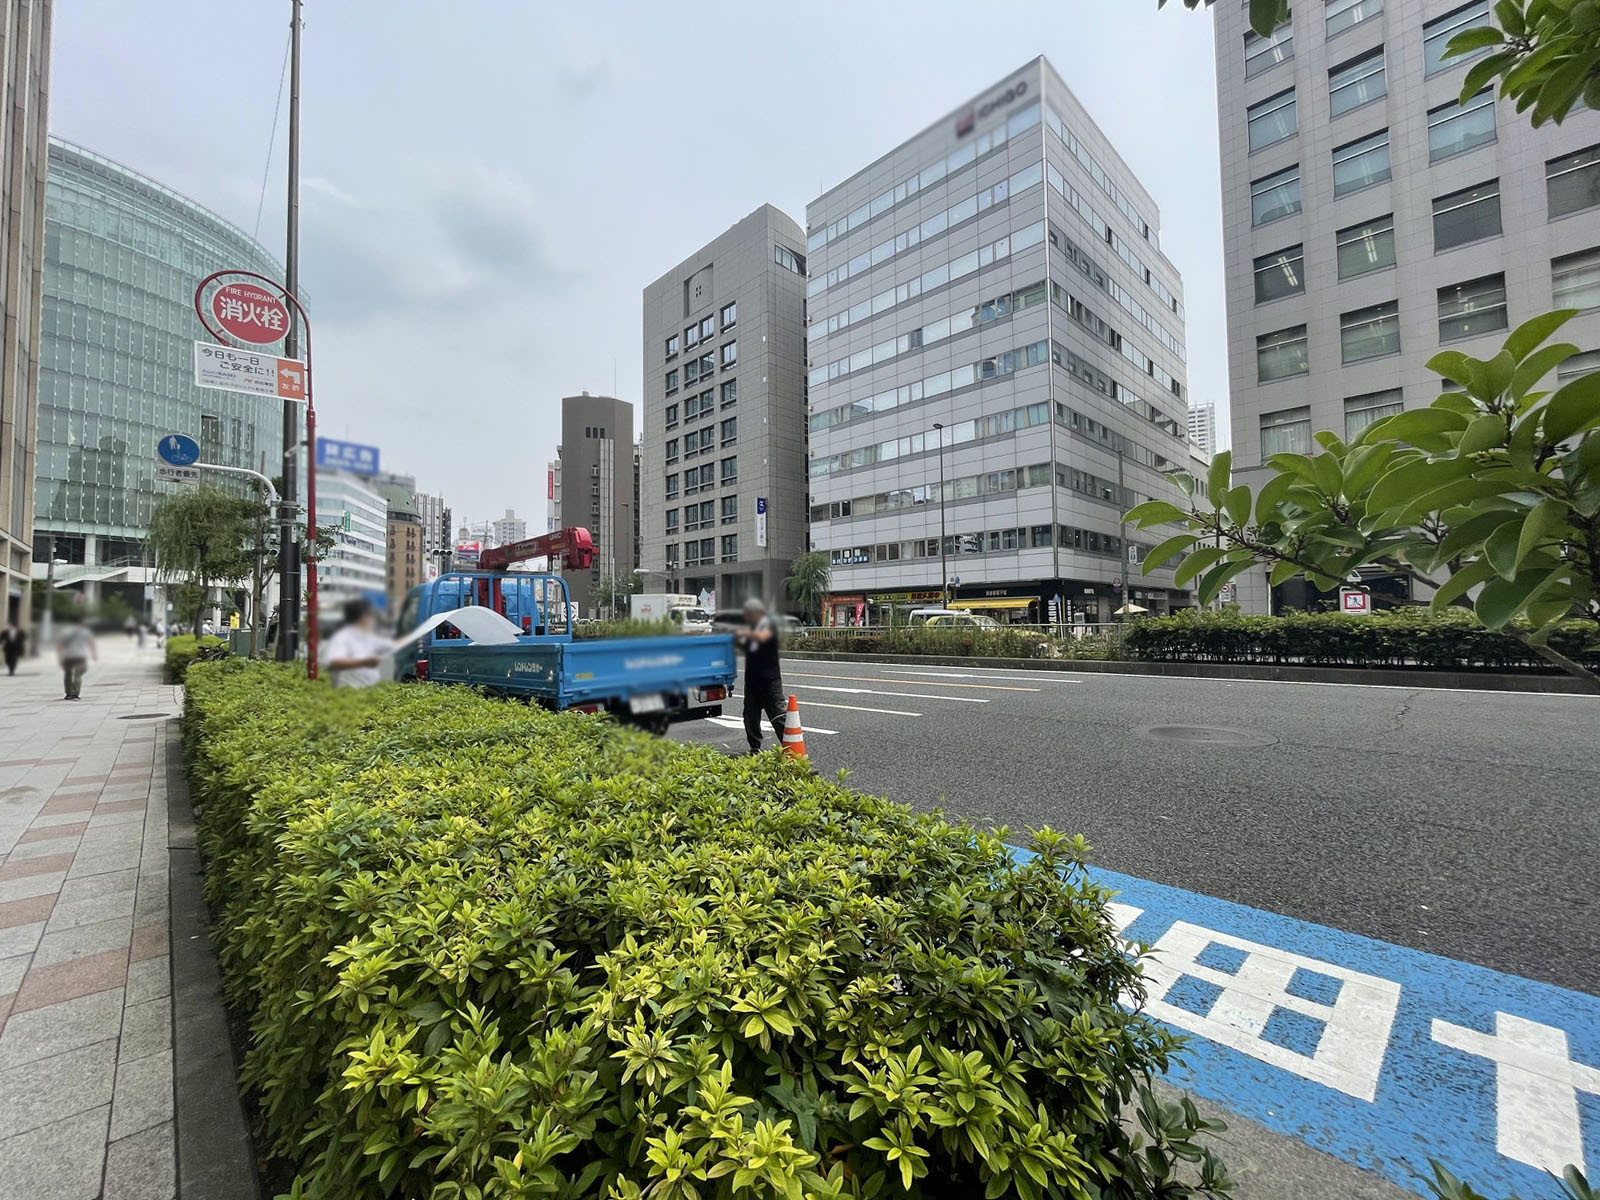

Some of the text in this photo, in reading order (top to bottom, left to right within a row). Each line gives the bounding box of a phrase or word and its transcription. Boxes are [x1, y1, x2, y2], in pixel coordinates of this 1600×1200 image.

[226, 286, 277, 304] FIRE HYDRANT
[220, 296, 284, 332] 消火栓
[202, 347, 260, 366] 今日も一日
[159, 468, 199, 479] 歩行者優先
